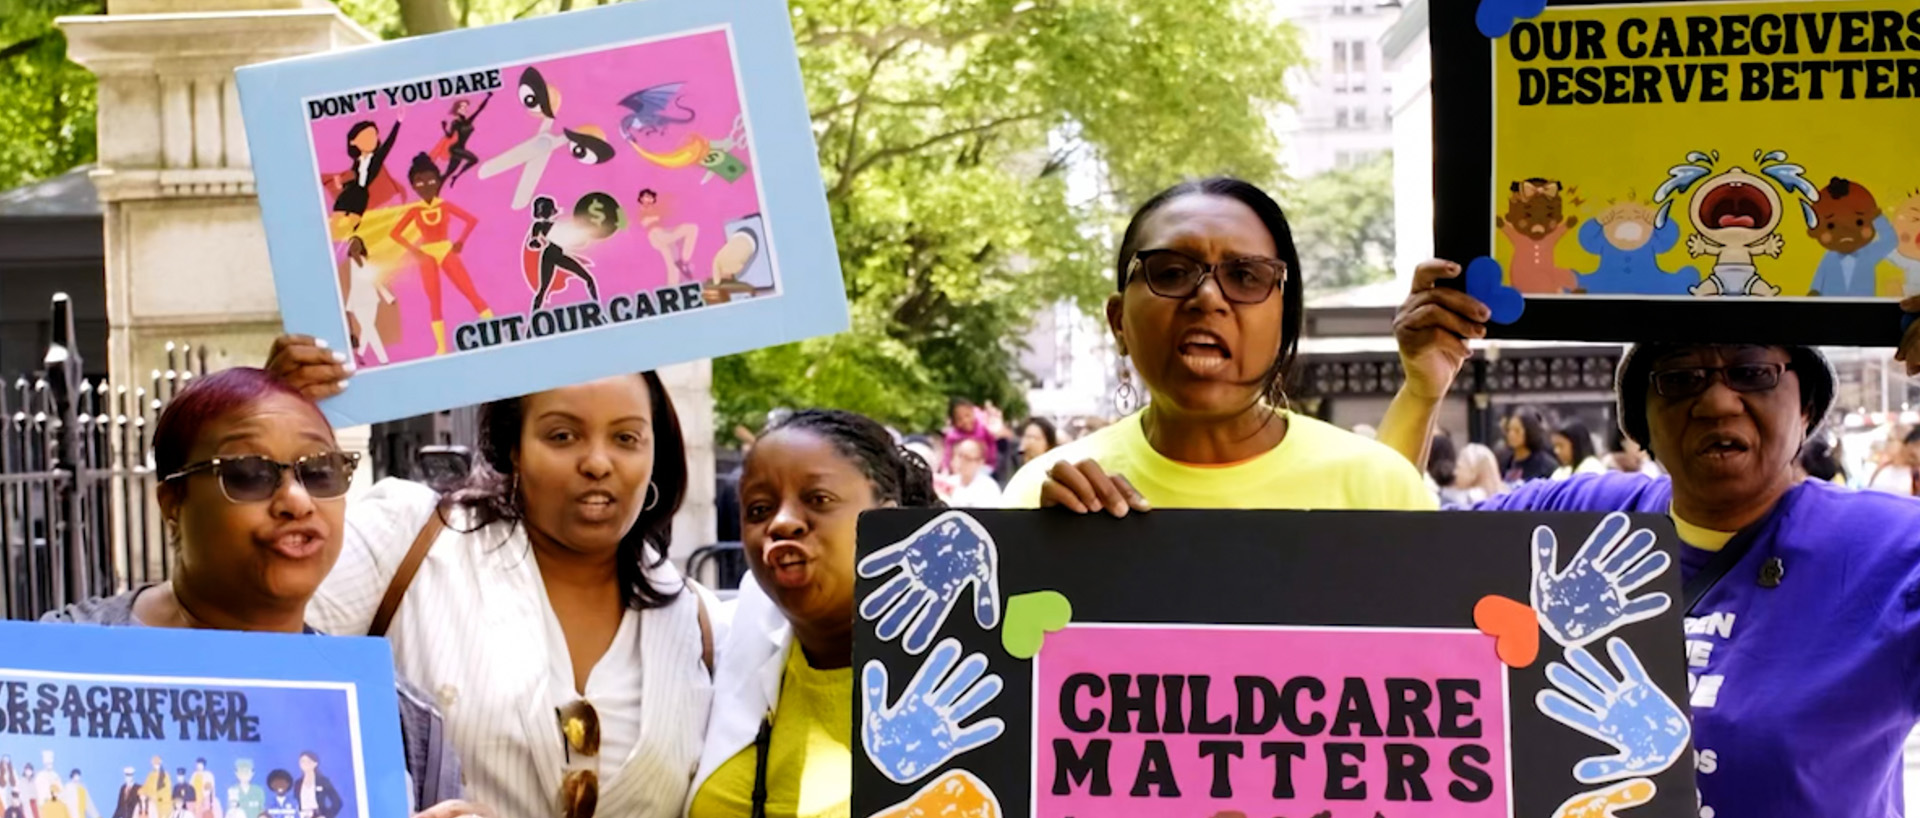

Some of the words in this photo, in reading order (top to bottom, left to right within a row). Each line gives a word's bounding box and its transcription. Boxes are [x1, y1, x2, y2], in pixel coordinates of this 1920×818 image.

[1510, 19, 1607, 62] OUR
[307, 89, 378, 120] DON'T
[382, 80, 433, 107] YOU
[437, 68, 503, 98] DARE
[1518, 63, 1729, 106] DESERVE
[1740, 59, 1920, 101] BETTER
[455, 316, 525, 352] CUT
[530, 302, 602, 338] OUR
[609, 283, 704, 321] CARE
[37, 683, 248, 720] SACRIFICED
[63, 709, 164, 740] THAN
[172, 716, 261, 742] TIME
[1059, 672, 1483, 738] CHILDCARE
[1051, 738, 1495, 802] MATTERS
